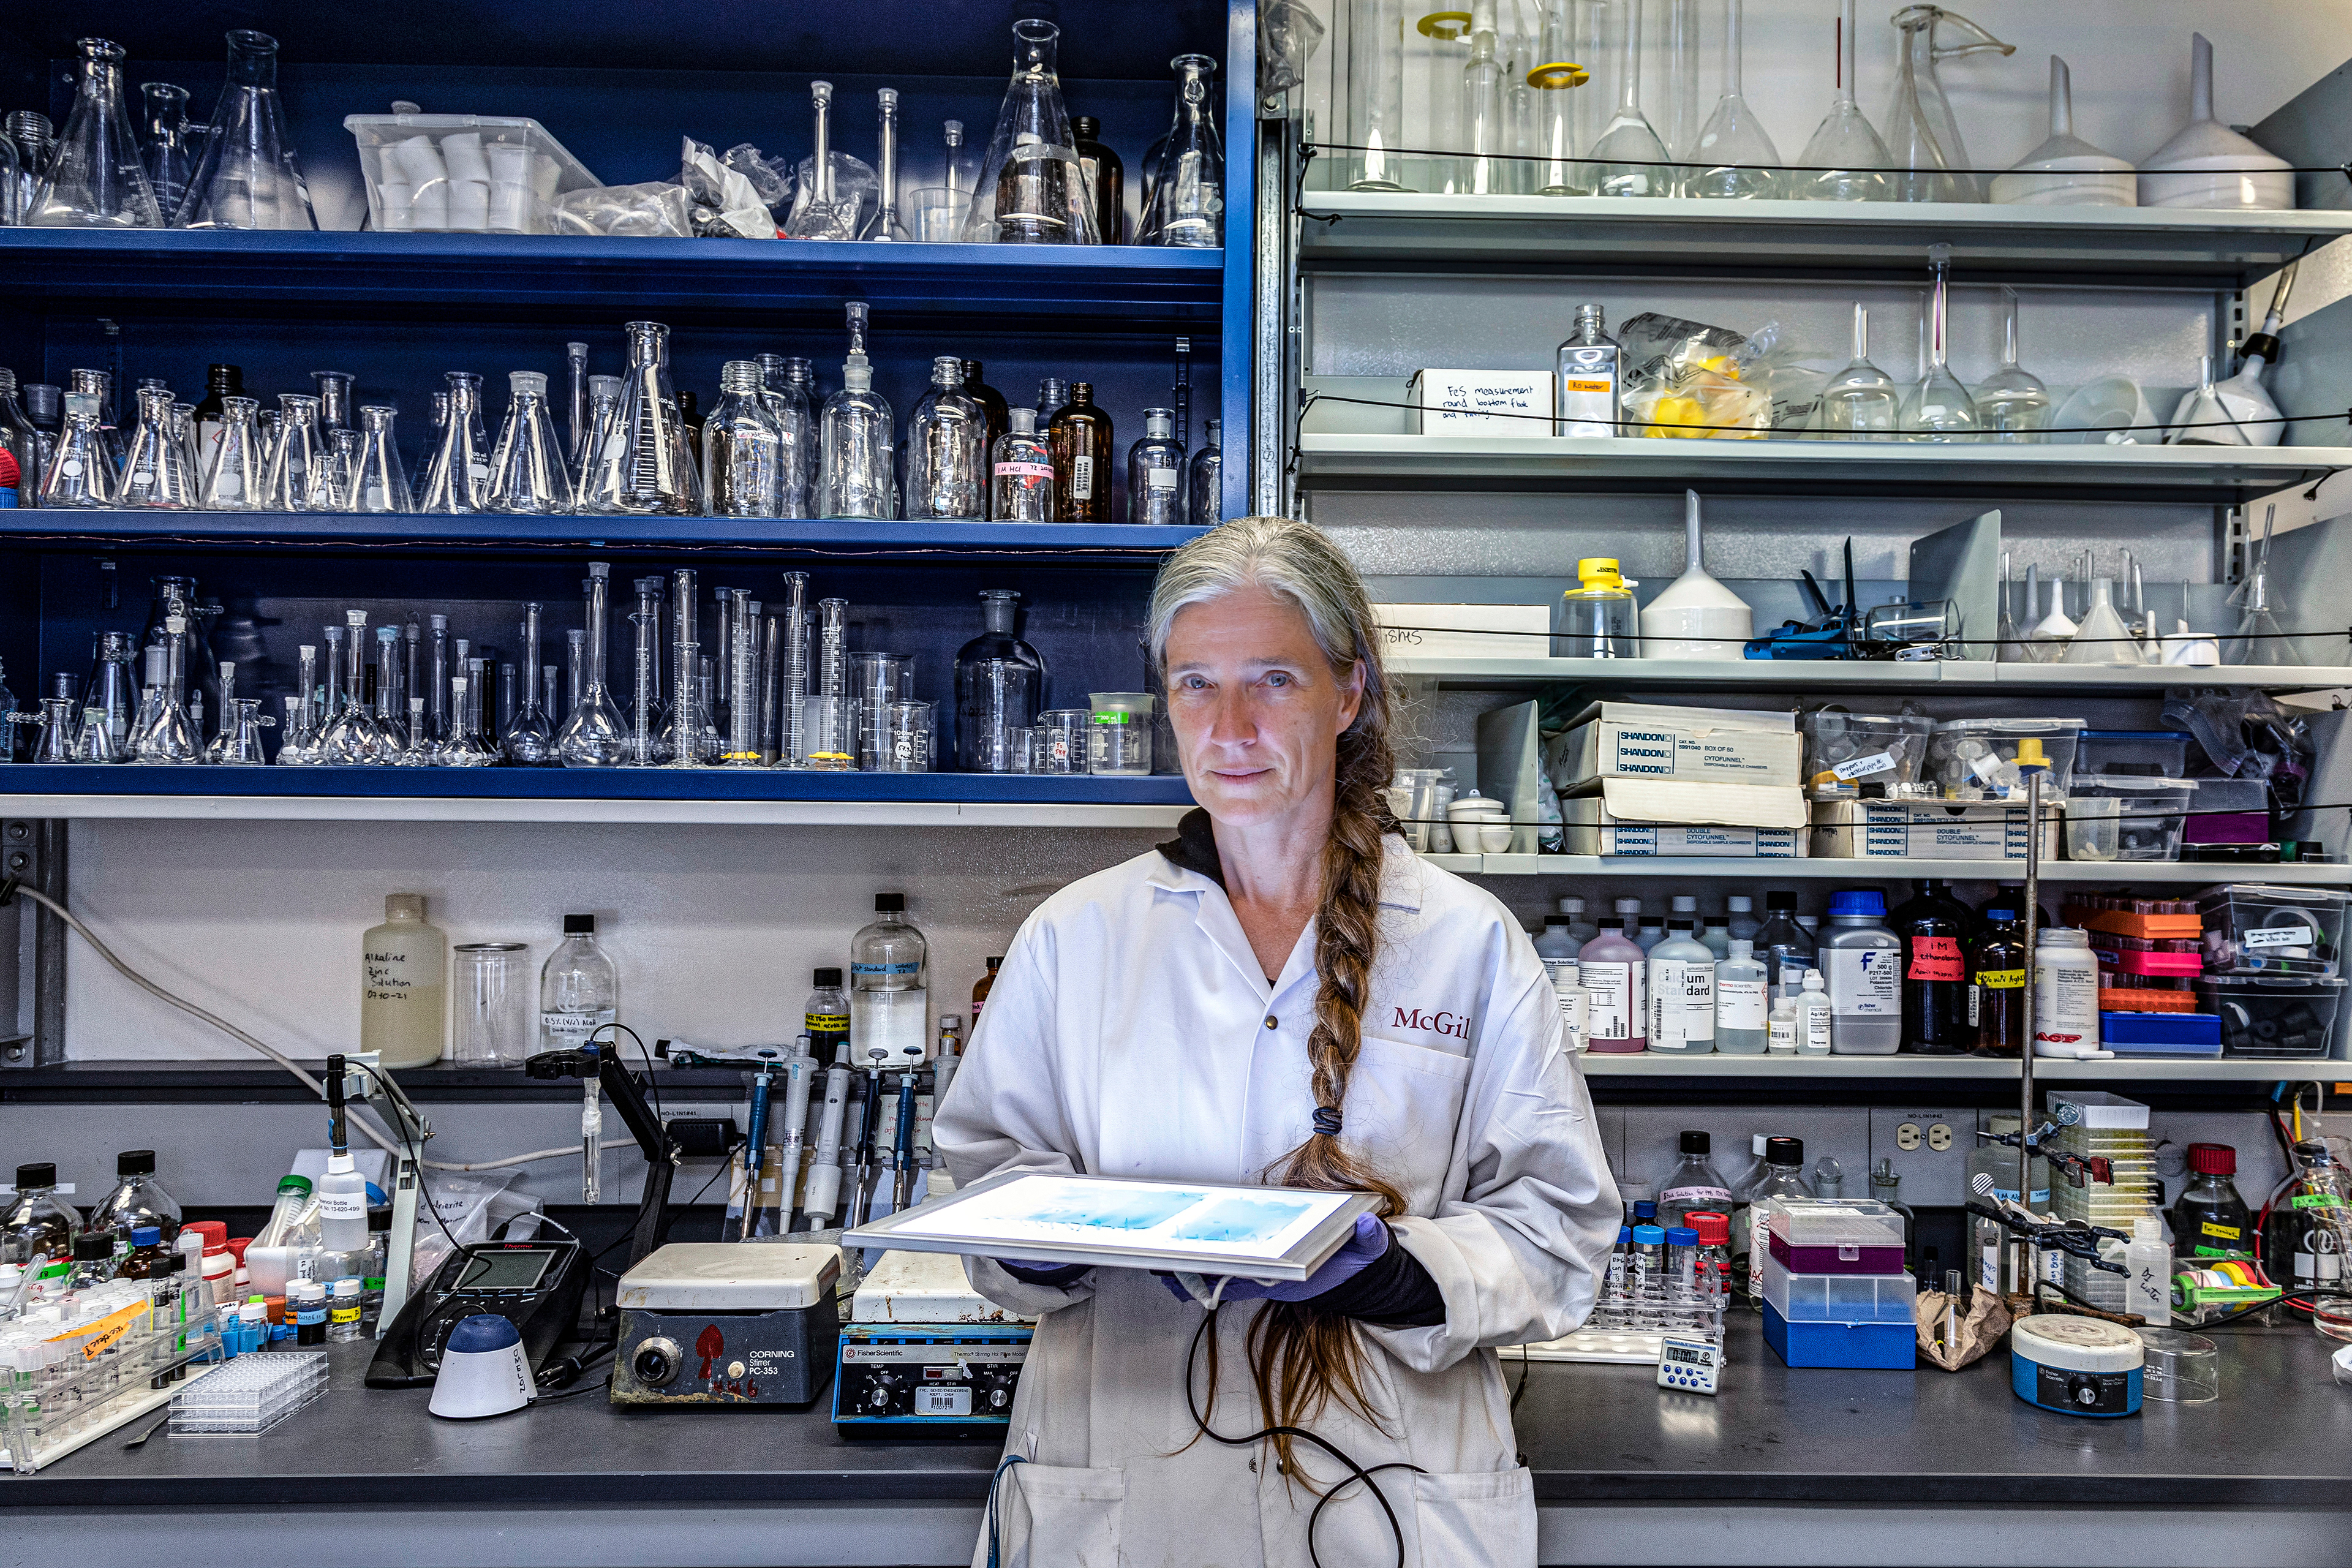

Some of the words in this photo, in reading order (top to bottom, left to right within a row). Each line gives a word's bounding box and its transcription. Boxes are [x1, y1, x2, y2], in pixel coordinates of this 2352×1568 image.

[1447, 385, 1466, 397] FeS
[1475, 386, 1533, 396] measurement
[1443, 398, 1468, 407] round
[1621, 732, 1665, 742] SHANDON
[1620, 748, 1664, 758] SHANDON
[1619, 764, 1664, 774] SHANDON
[365, 952, 405, 962] Alkaline
[368, 967, 389, 976] Zinc
[2009, 974, 2025, 984] AgNO
[1391, 1006, 1471, 1041] McGil
[749, 1350, 795, 1359] CORNING
[749, 1359, 771, 1367] Stirrer
[749, 1366, 778, 1375] PC-353
